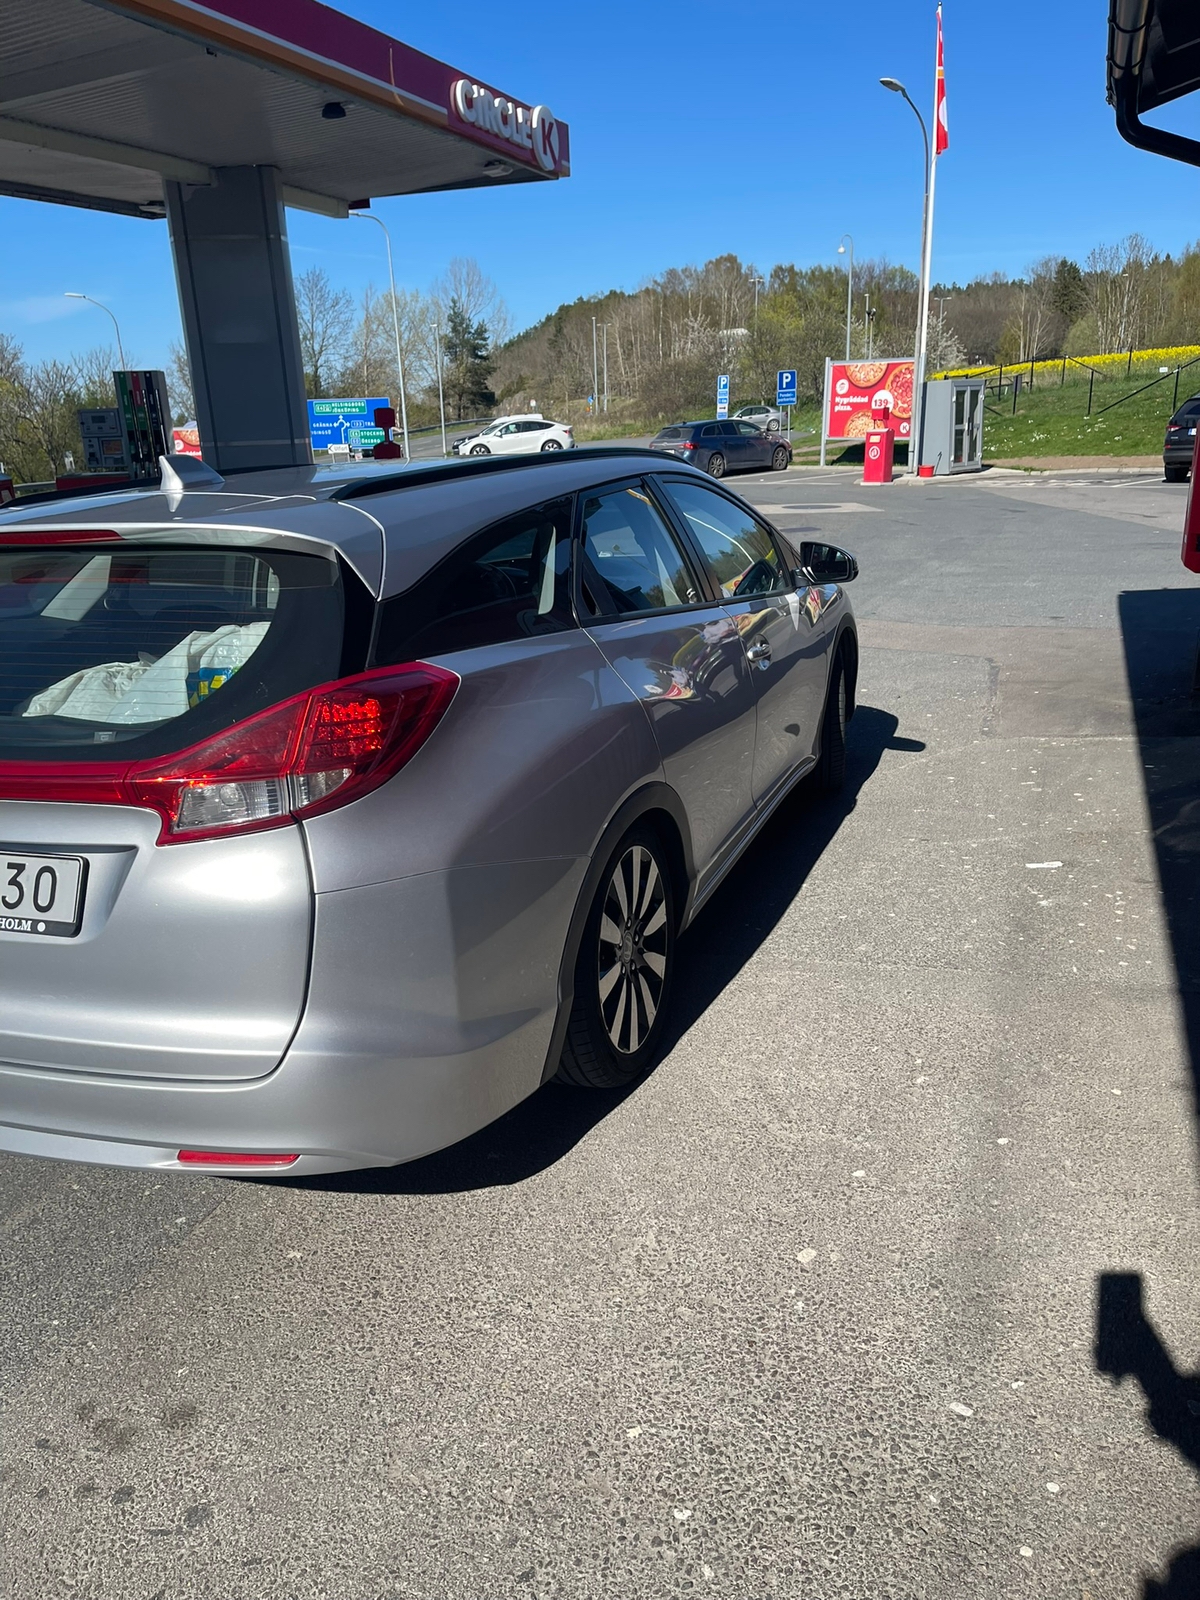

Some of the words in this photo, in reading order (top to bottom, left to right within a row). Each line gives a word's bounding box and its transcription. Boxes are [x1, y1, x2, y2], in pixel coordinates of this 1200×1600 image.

[455, 79, 532, 149] CIRCLE
[537, 111, 558, 169] K
[720, 377, 727, 388] P
[783, 373, 791, 388] P
